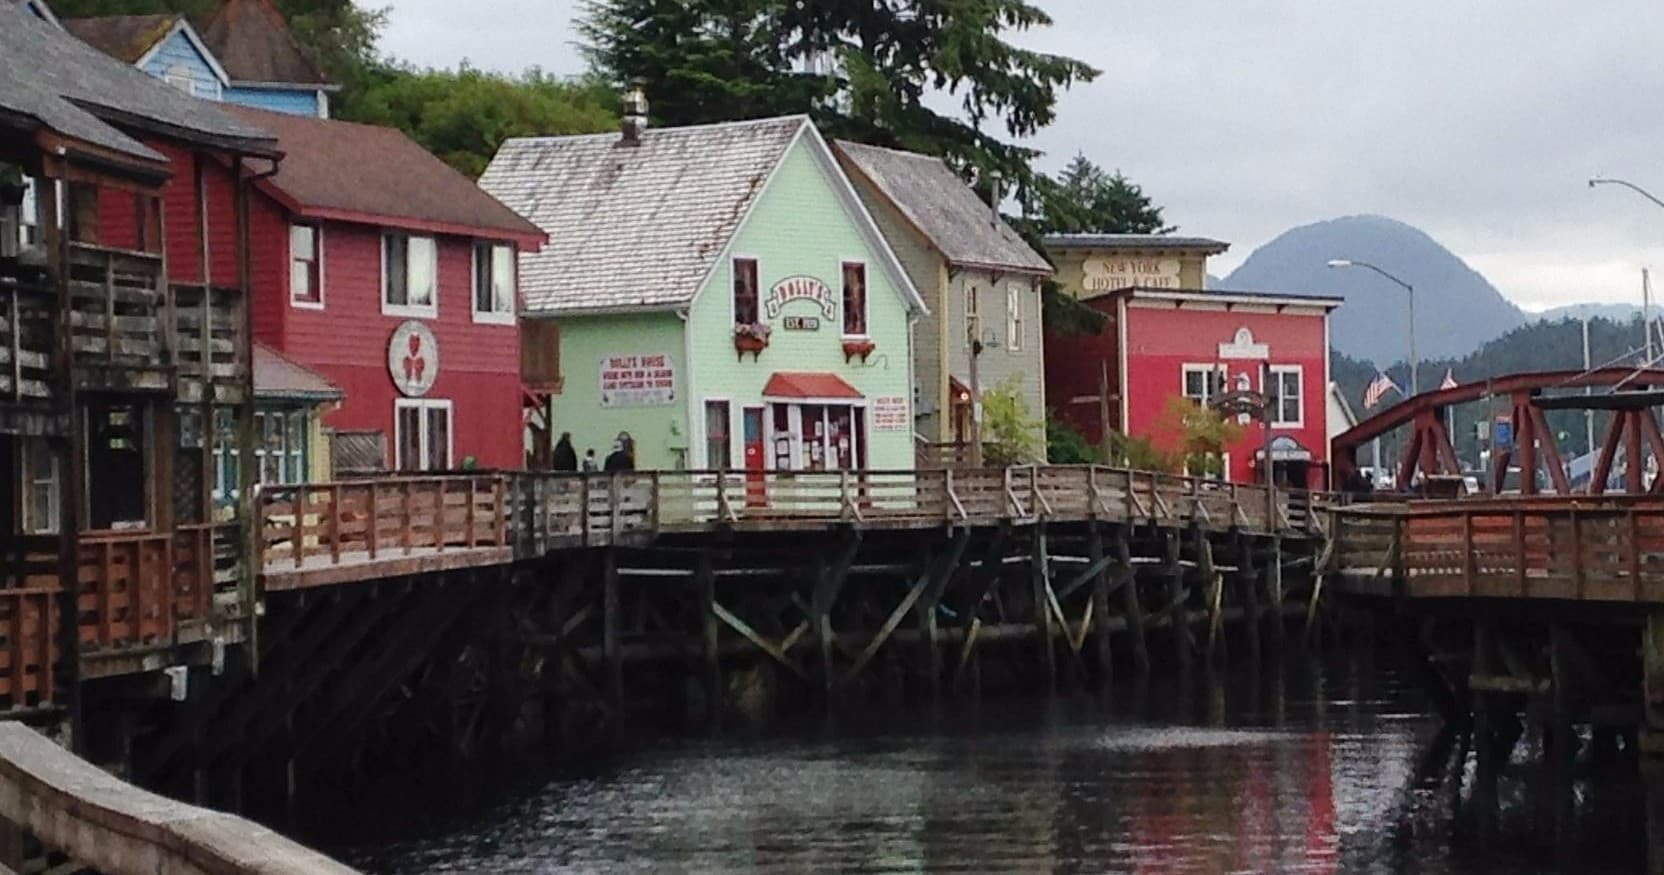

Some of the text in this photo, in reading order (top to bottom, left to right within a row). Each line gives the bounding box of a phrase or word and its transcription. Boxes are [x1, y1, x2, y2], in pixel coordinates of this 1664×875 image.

[1103, 260, 1161, 273] NEW YORK
[1092, 276, 1128, 288] HOTEL
[778, 279, 823, 300] DOLLY'S
